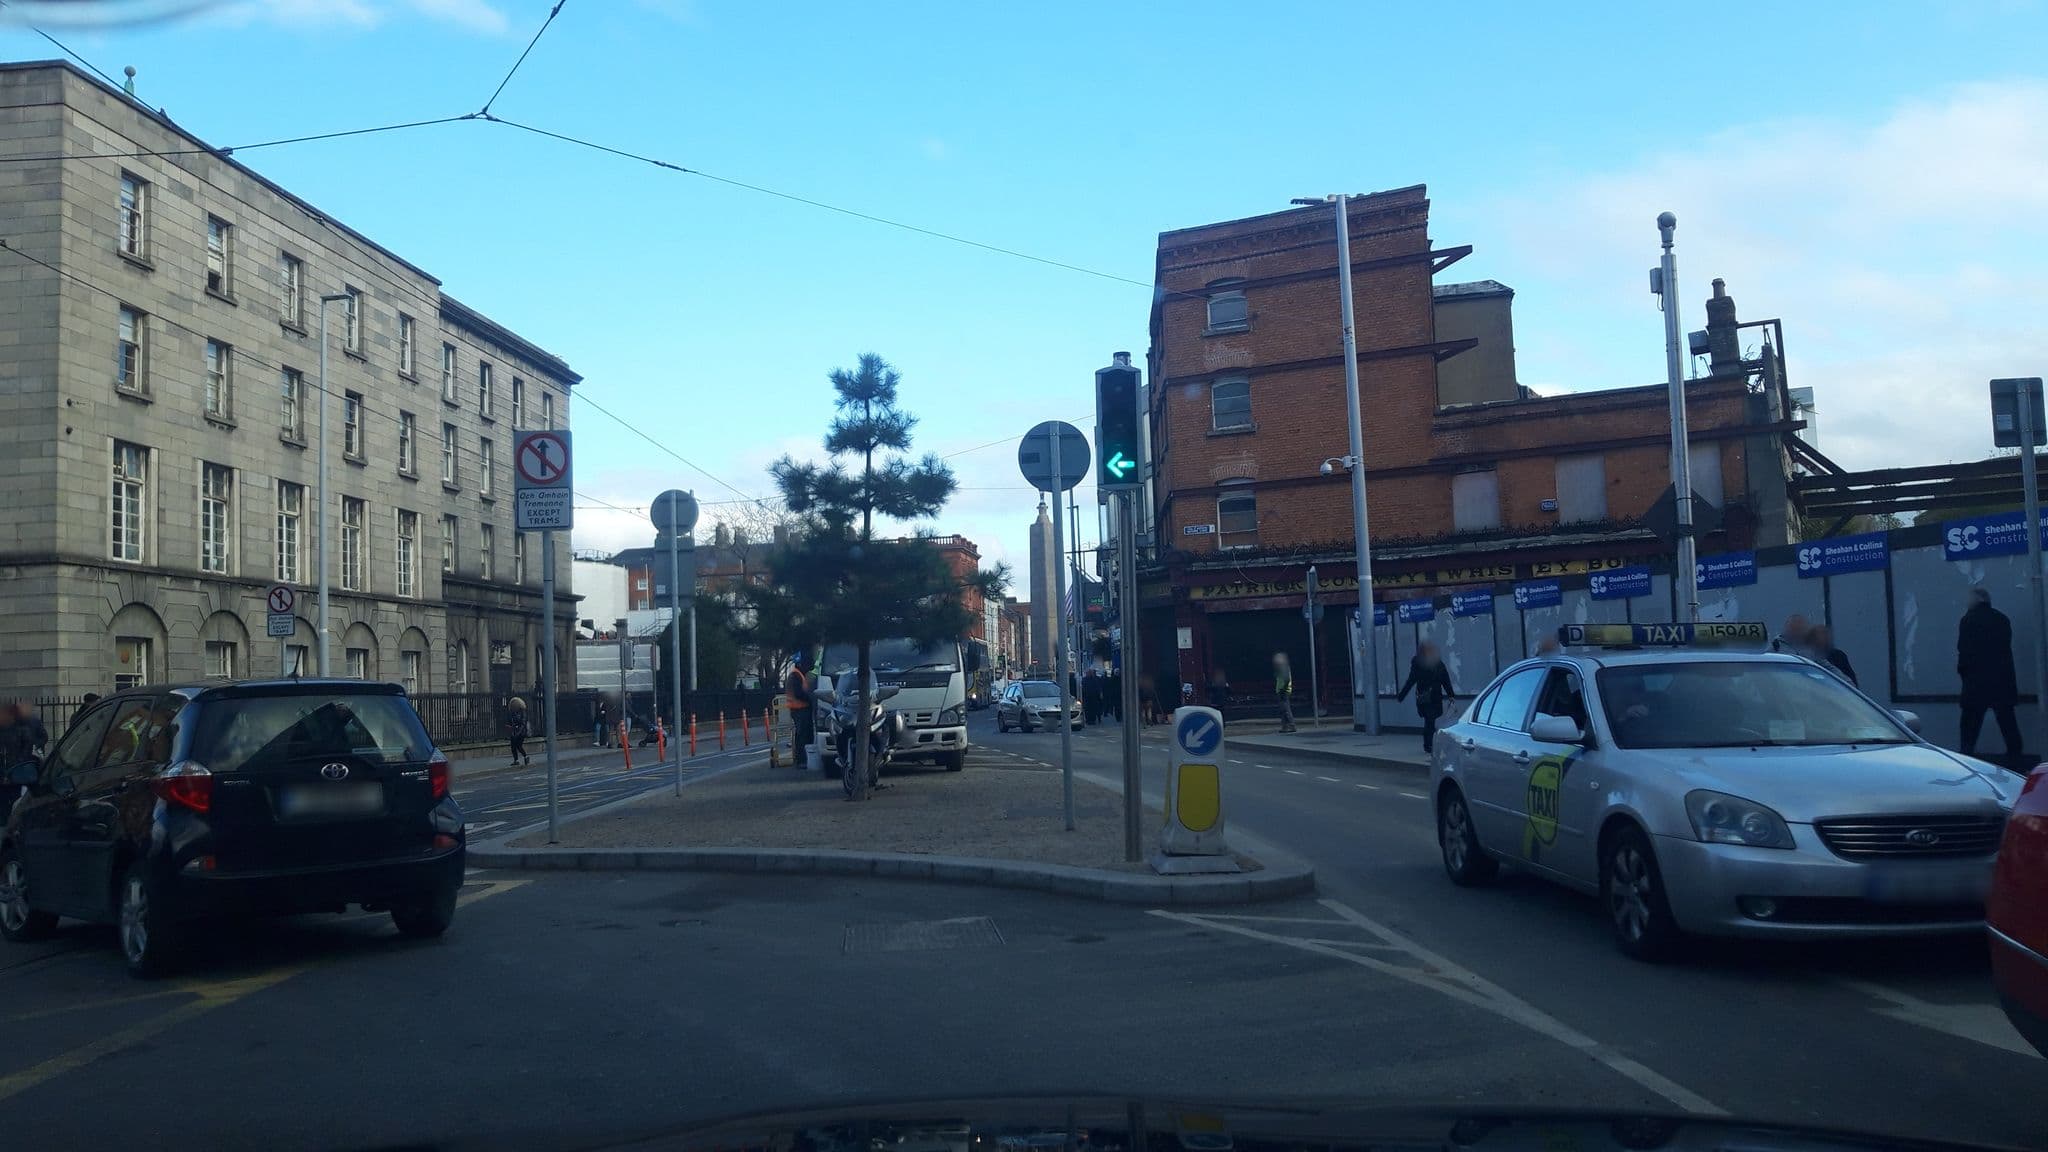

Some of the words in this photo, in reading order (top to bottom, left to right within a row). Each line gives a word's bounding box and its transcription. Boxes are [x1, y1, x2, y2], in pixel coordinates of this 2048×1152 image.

[527, 508, 561, 517] EXCEPT
[528, 516, 561, 525] TRAMS
[1985, 522, 2021, 534] Sheahan
[1825, 545, 1853, 556] Sheahan
[1859, 540, 1884, 551] Collins
[1734, 559, 1752, 568] Collins
[1825, 551, 1884, 565] Construction
[1708, 567, 1753, 580] Construction
[1570, 628, 1583, 642] D
[1641, 625, 1686, 643] TAXI
[1530, 784, 1557, 819] TAXI
